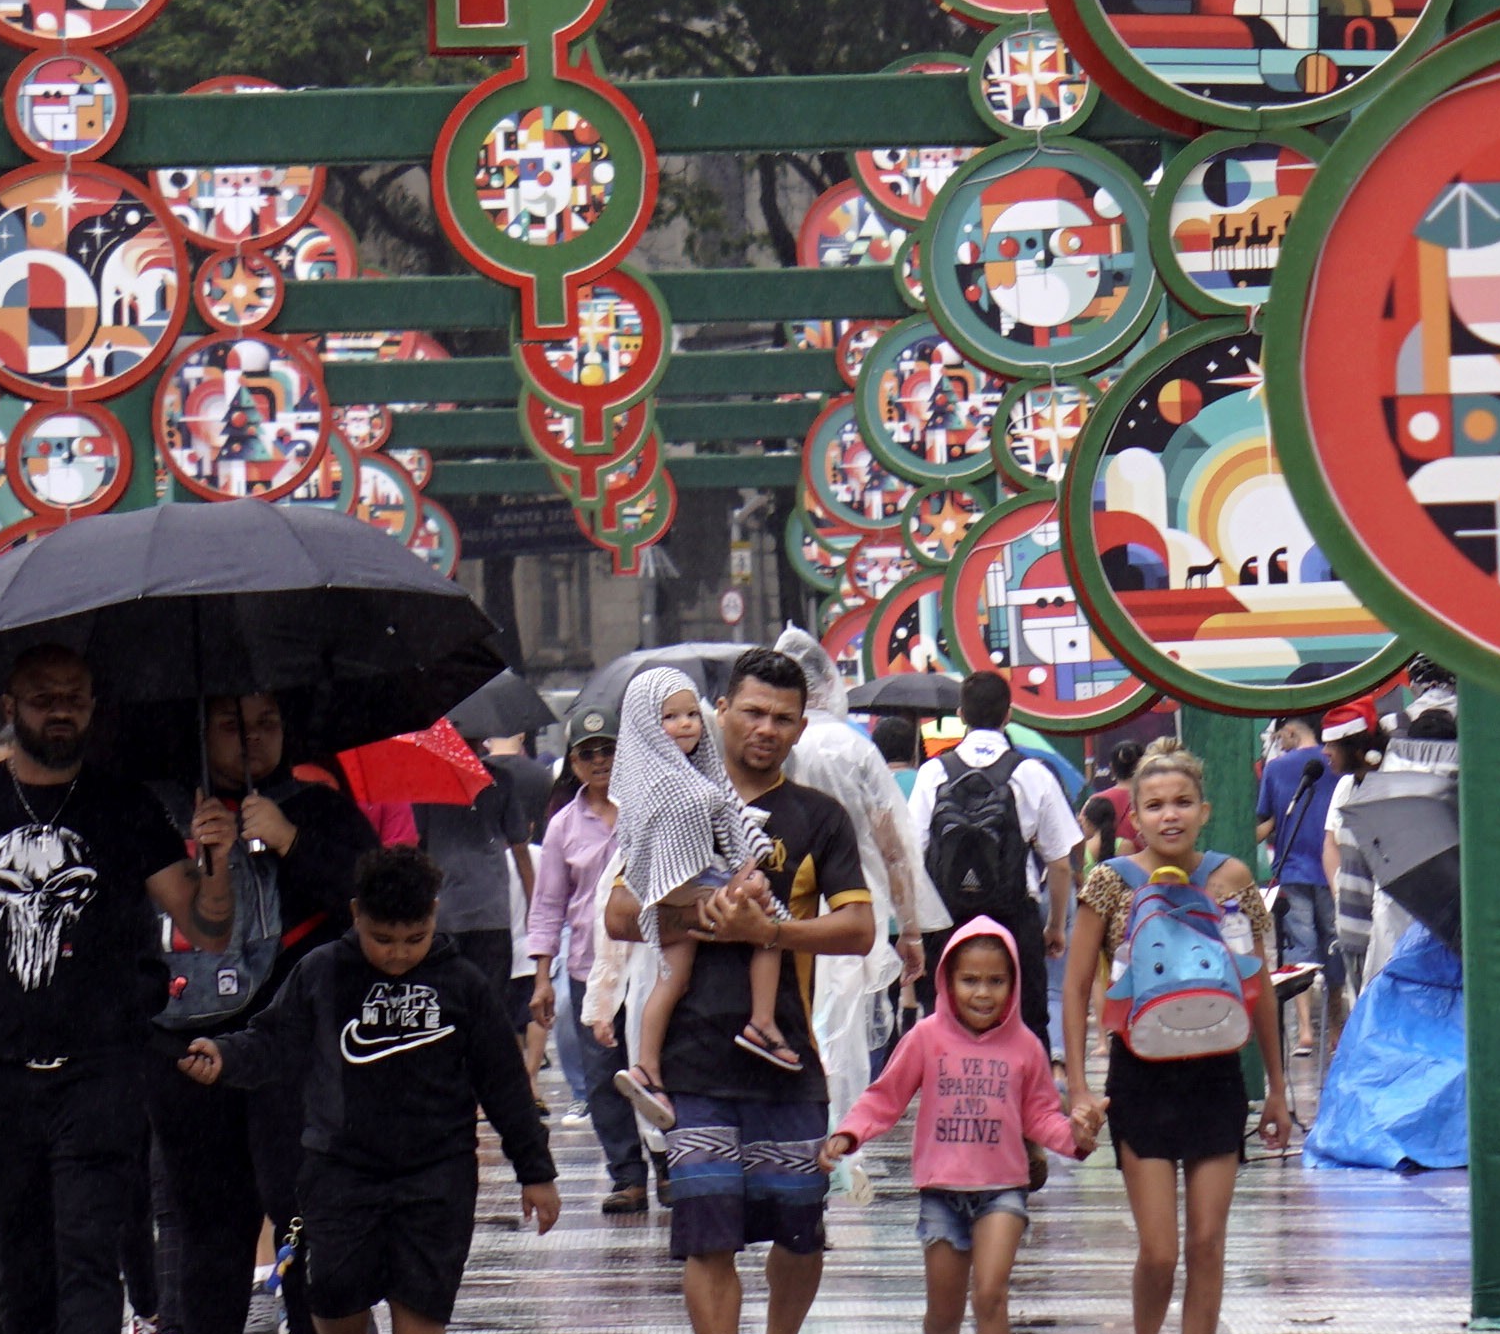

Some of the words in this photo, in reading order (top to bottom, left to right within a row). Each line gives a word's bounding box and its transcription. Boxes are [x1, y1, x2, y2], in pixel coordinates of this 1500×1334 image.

[362, 982, 440, 1009] AIR
[361, 1007, 440, 1028] NIKE
[938, 1058, 983, 1077] LVE
[988, 1059, 1009, 1078] TO
[953, 1097, 988, 1116] AND
[936, 1117, 1001, 1144] SHINE
